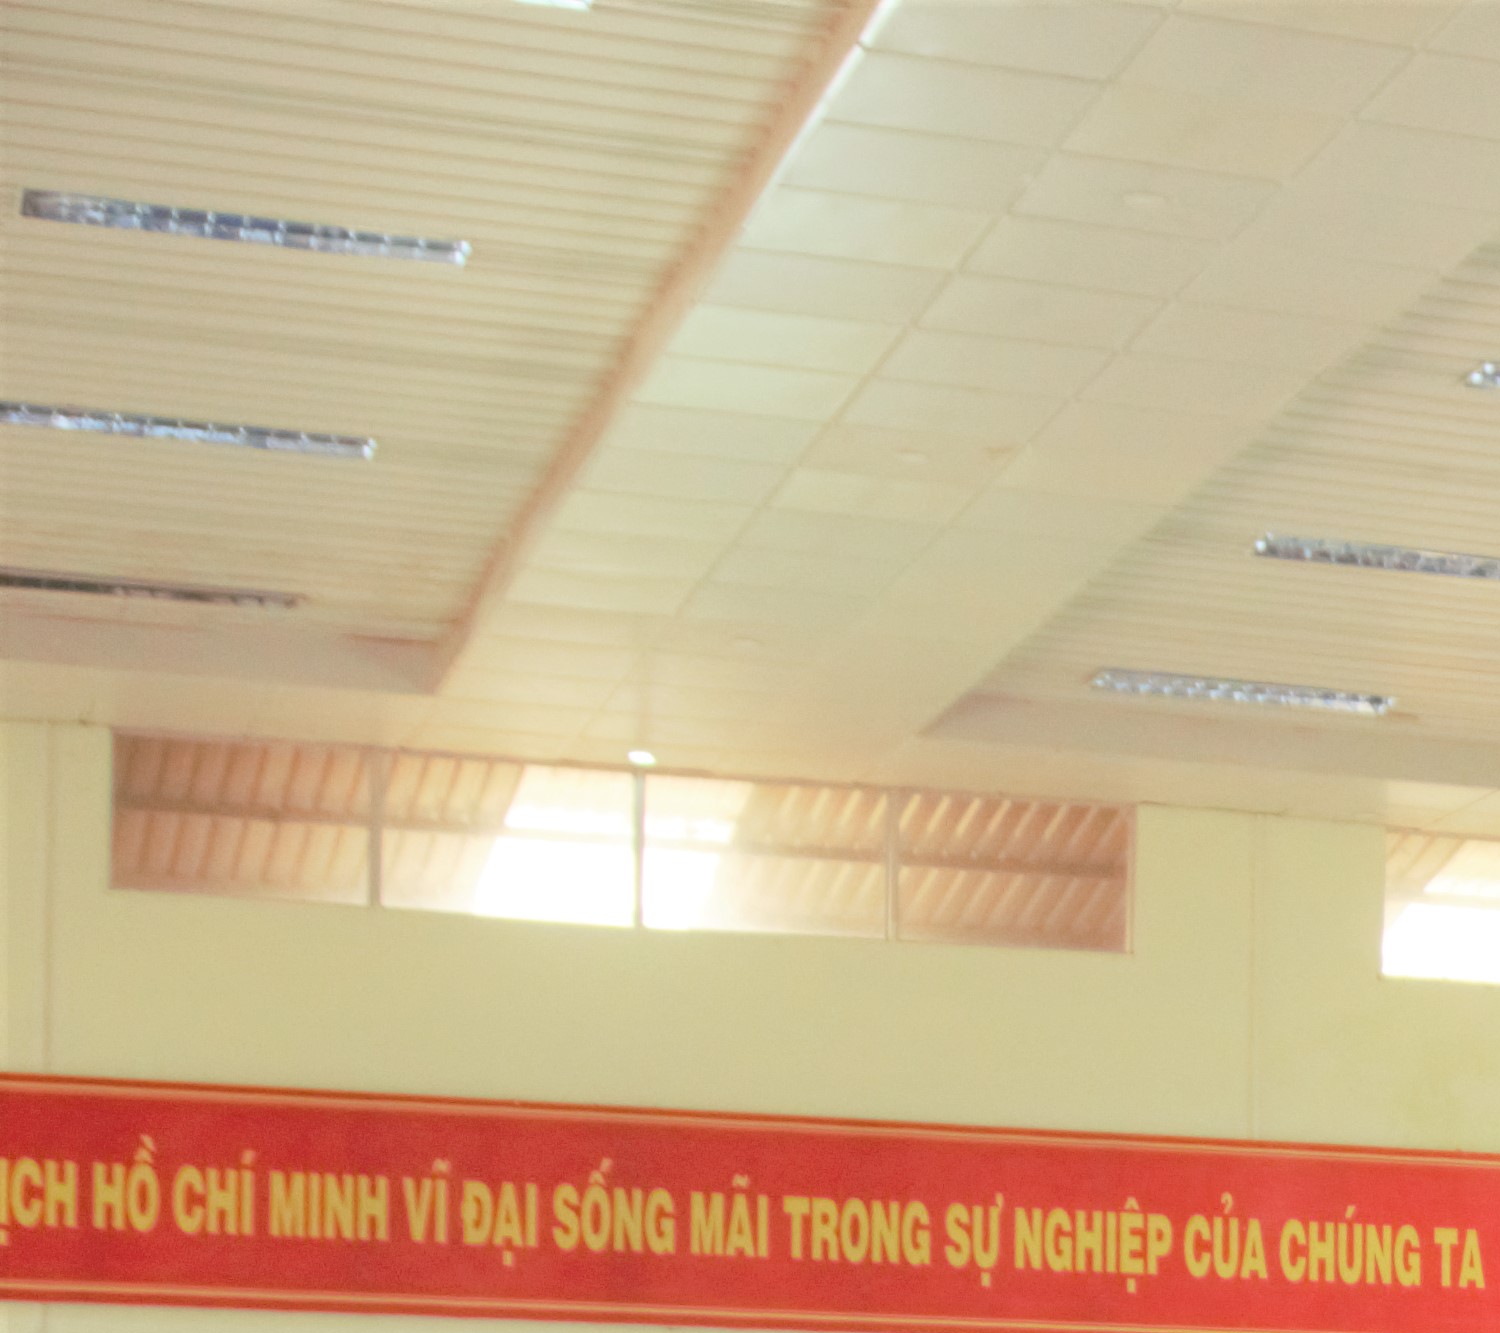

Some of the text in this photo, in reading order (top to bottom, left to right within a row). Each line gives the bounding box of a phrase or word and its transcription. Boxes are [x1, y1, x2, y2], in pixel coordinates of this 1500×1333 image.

[92, 1135, 160, 1232] HỒ
[172, 1151, 254, 1236] CHÍ
[268, 1170, 389, 1242] MINH
[402, 1159, 450, 1244] VĨ
[459, 1179, 539, 1267] ĐẠI
[552, 1158, 676, 1256] SỐNG
[689, 1174, 770, 1259] MÃI
[782, 1195, 932, 1267] TRONG
[943, 1193, 1005, 1288] SỰ
[1013, 1196, 1174, 1294] NGHIỆP
[1182, 1191, 1269, 1281] CỦA
[1278, 1204, 1423, 1288] CHÚNG
[1432, 1226, 1486, 1290] TA
